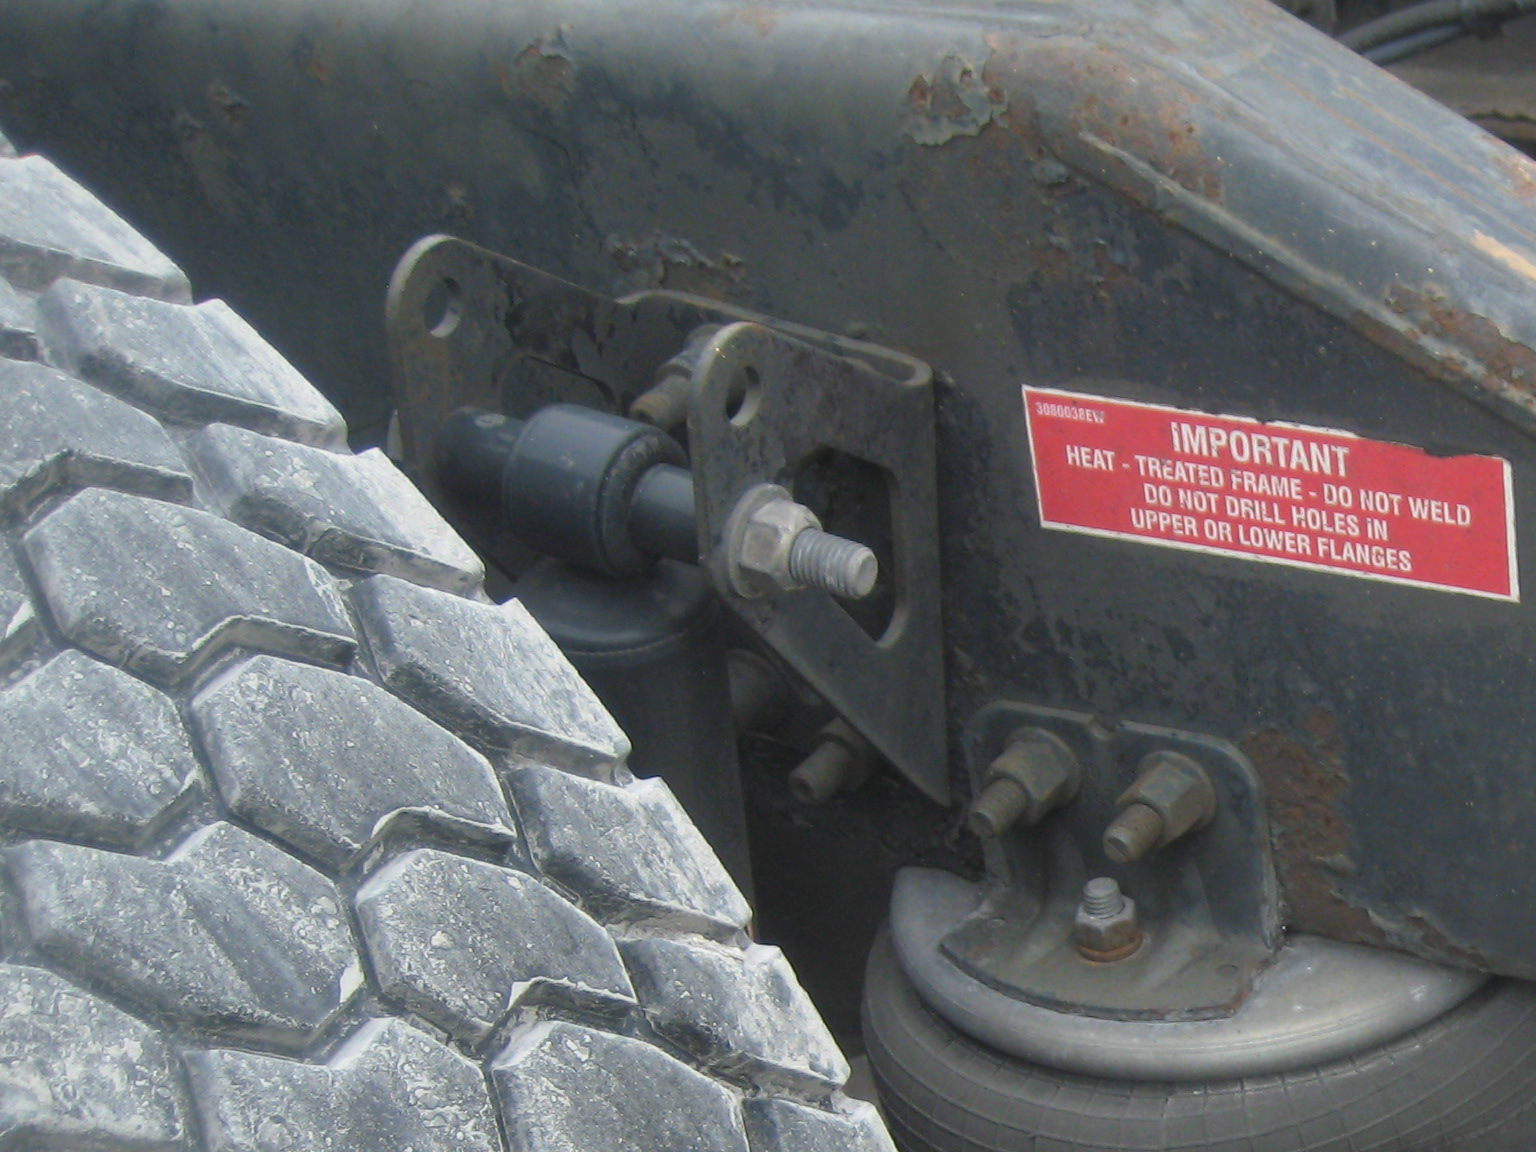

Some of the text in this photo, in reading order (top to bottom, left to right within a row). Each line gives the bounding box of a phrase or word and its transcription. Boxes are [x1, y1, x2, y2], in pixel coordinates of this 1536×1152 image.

[1171, 421, 1350, 476] IMPORTANT
[1067, 444, 1115, 471] HEAT
[1135, 454, 1225, 488] TREATED
[1231, 469, 1303, 500] FRAME
[1324, 483, 1353, 508] DO
[1360, 488, 1403, 516] NOT
[1408, 496, 1471, 526] WELD
[1144, 482, 1388, 541] DO NOT DRILL HOLES IN
[1131, 507, 1412, 572] UPPER OR LOWER FLANGES
